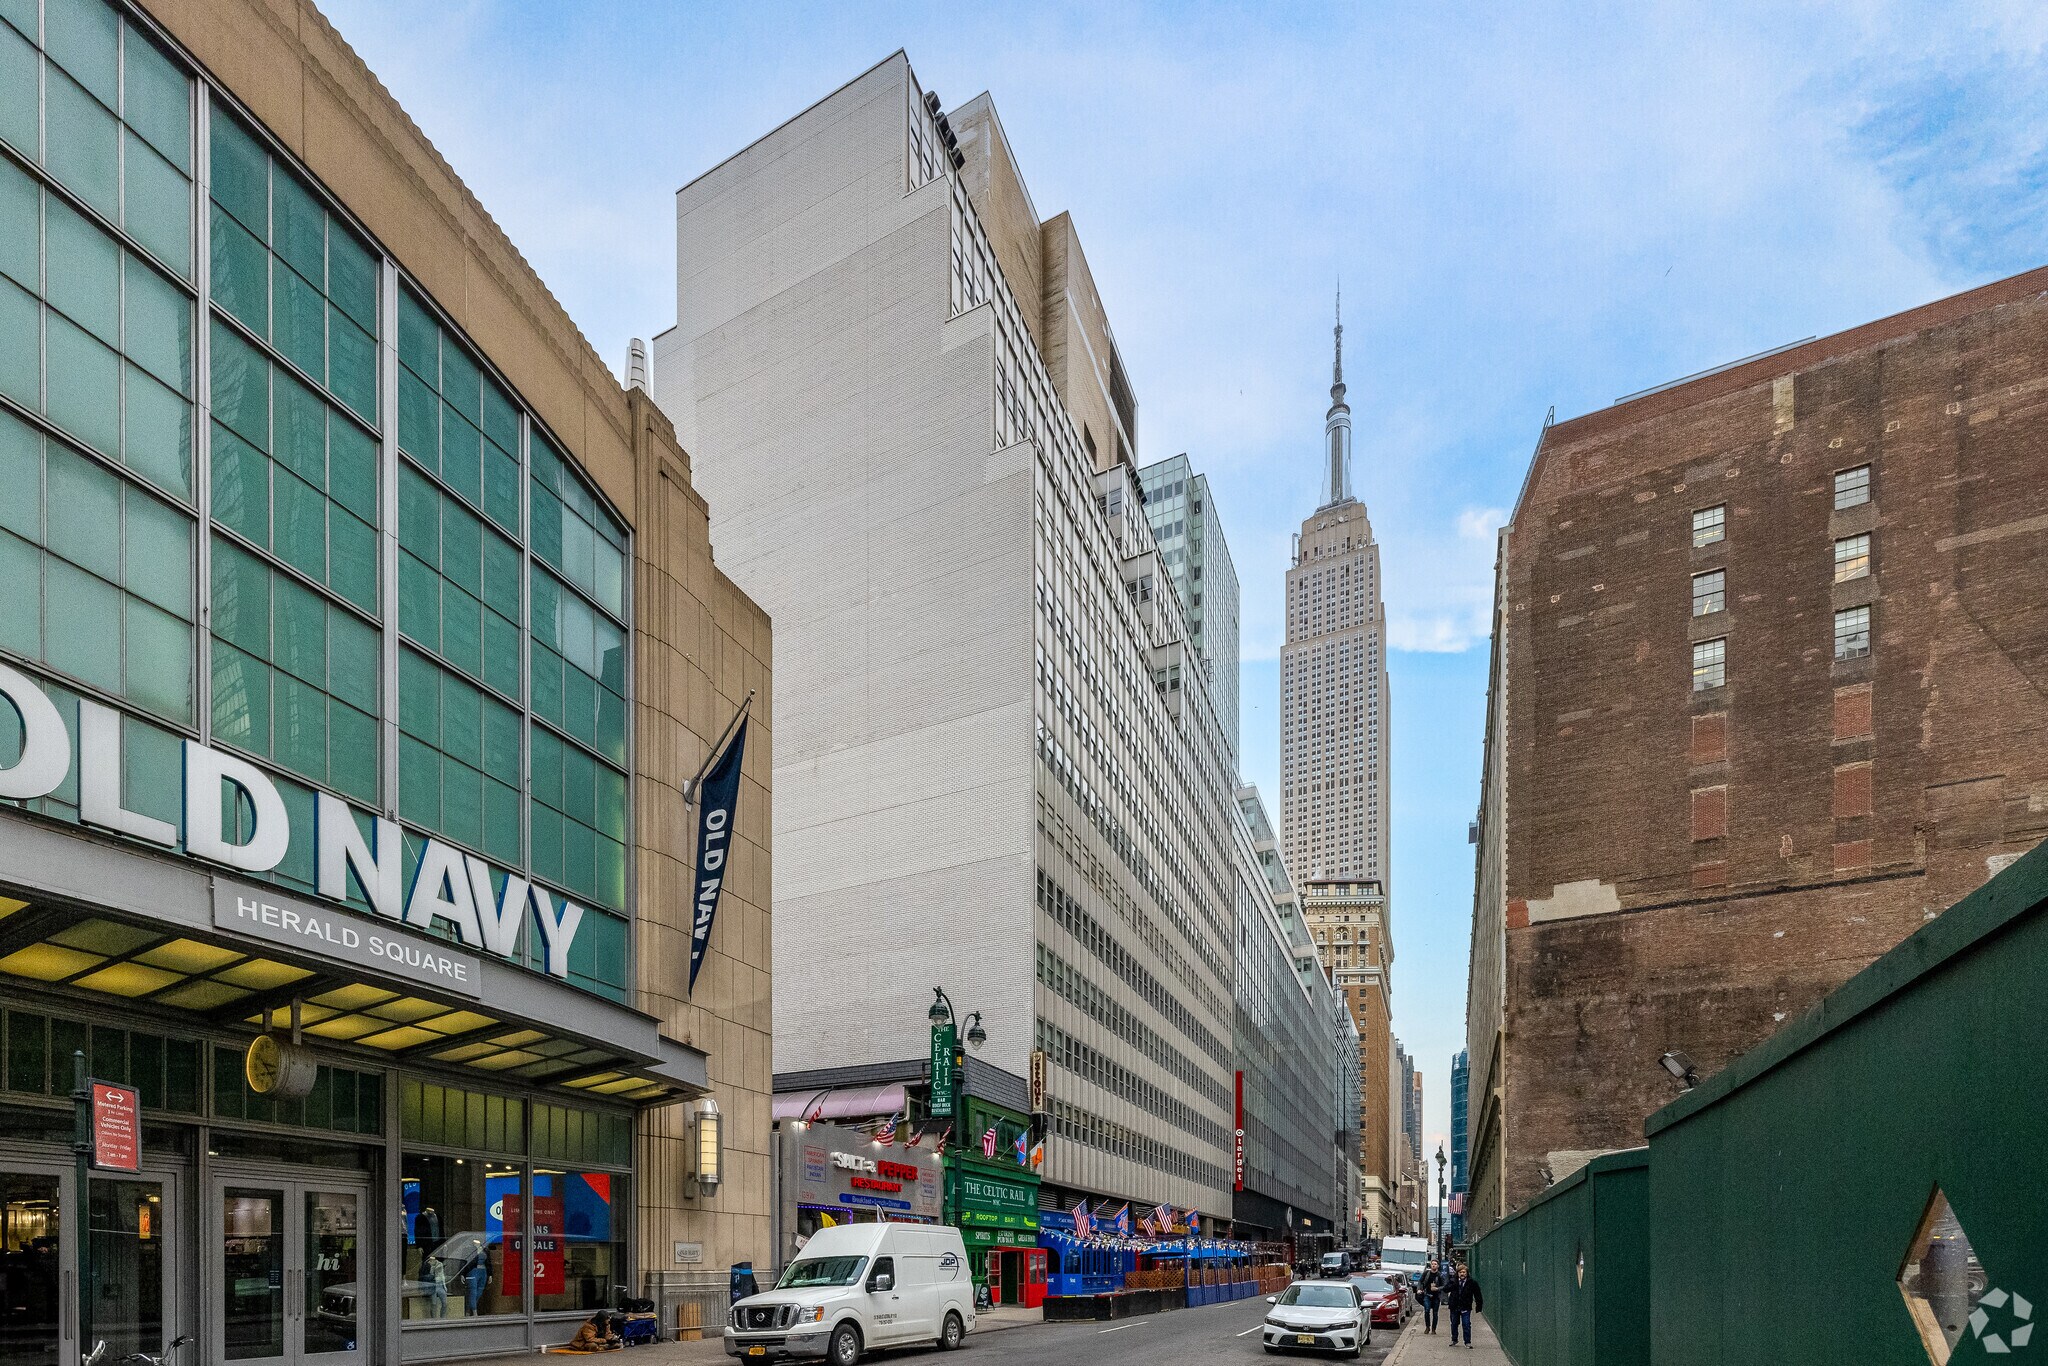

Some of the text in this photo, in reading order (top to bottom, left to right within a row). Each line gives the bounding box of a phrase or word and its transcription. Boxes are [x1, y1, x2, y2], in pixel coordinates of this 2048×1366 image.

[703, 808, 727, 872] OLD
[314, 790, 585, 979] NAVY
[237, 896, 468, 982] HERALD SQUARE
[934, 1033, 942, 1090] CELTIC
[943, 1047, 951, 1086] RAIL
[97, 1100, 133, 1113] Metered Parking
[101, 1122, 120, 1130] Vehicles
[102, 1116, 129, 1125] Commercial
[830, 1152, 866, 1170] SALT
[878, 1160, 918, 1180] PEPPER
[851, 1177, 902, 1192] RESTAURANT
[964, 1182, 1025, 1201] THE CELTIC RAIL
[315, 1252, 340, 1271] hi
